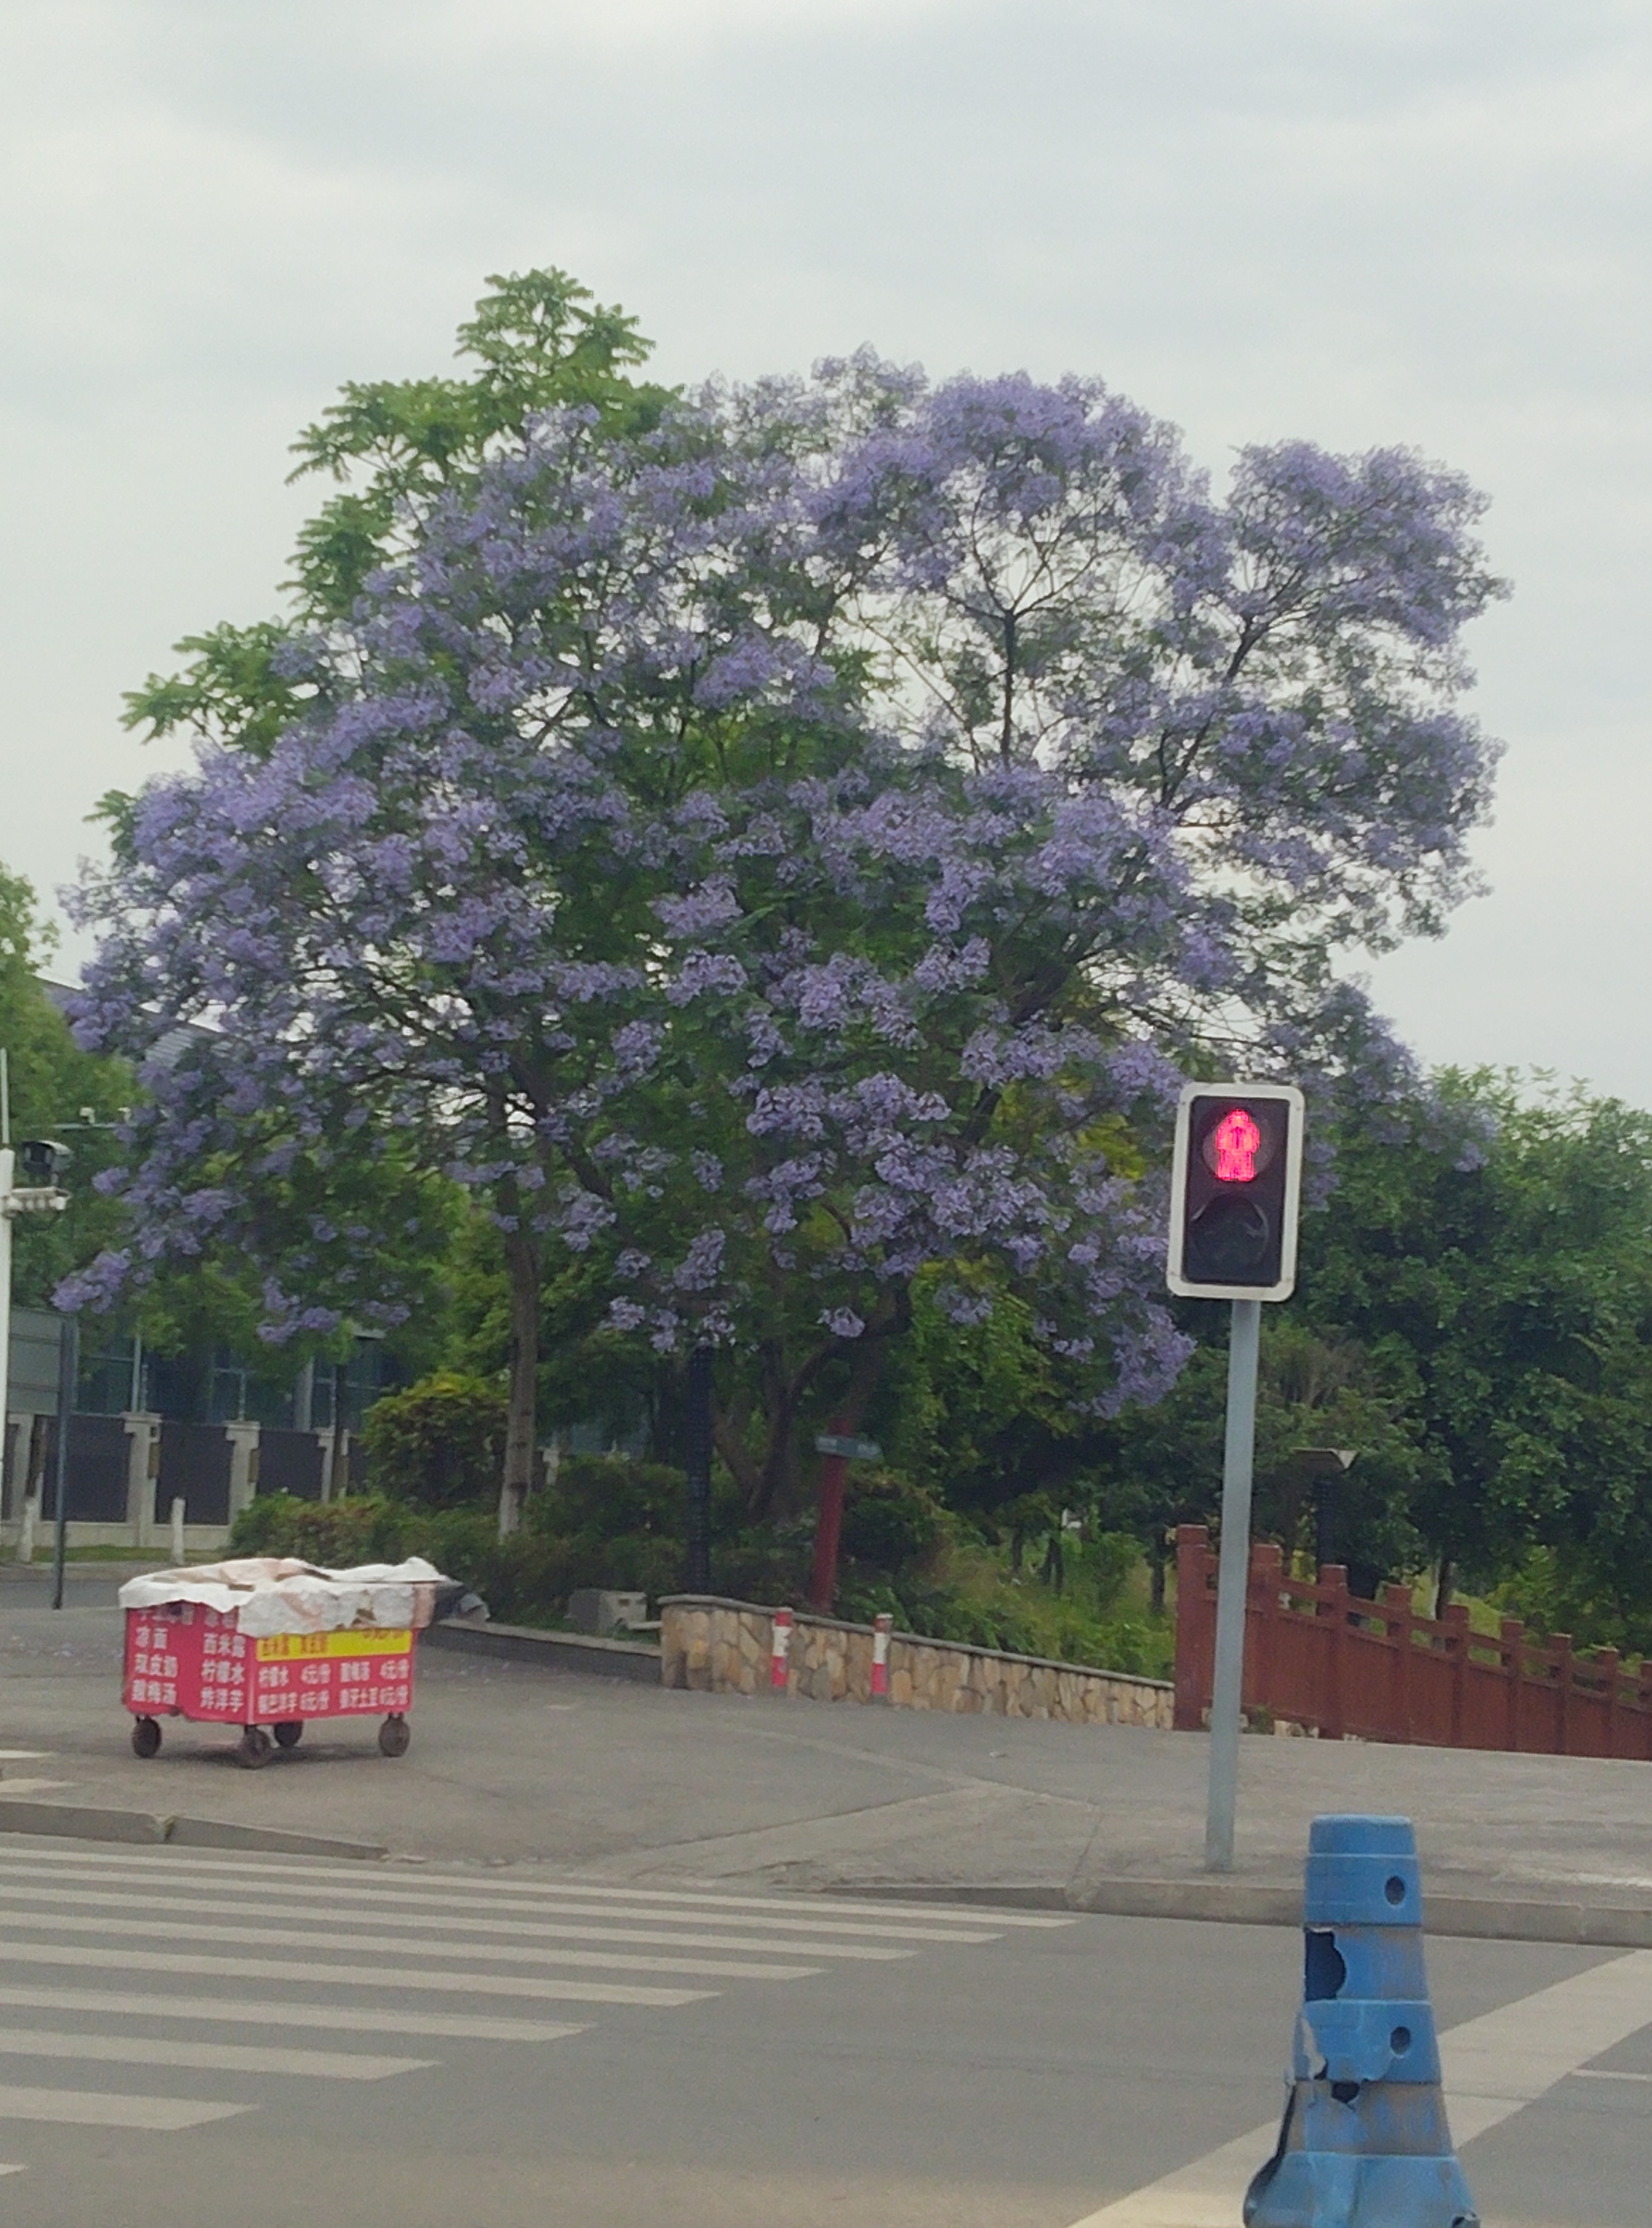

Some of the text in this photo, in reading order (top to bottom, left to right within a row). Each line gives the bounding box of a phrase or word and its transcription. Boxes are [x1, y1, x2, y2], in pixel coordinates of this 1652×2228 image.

[203, 1632, 246, 1658] 西米露
[201, 1659, 245, 1685] 柠檬水
